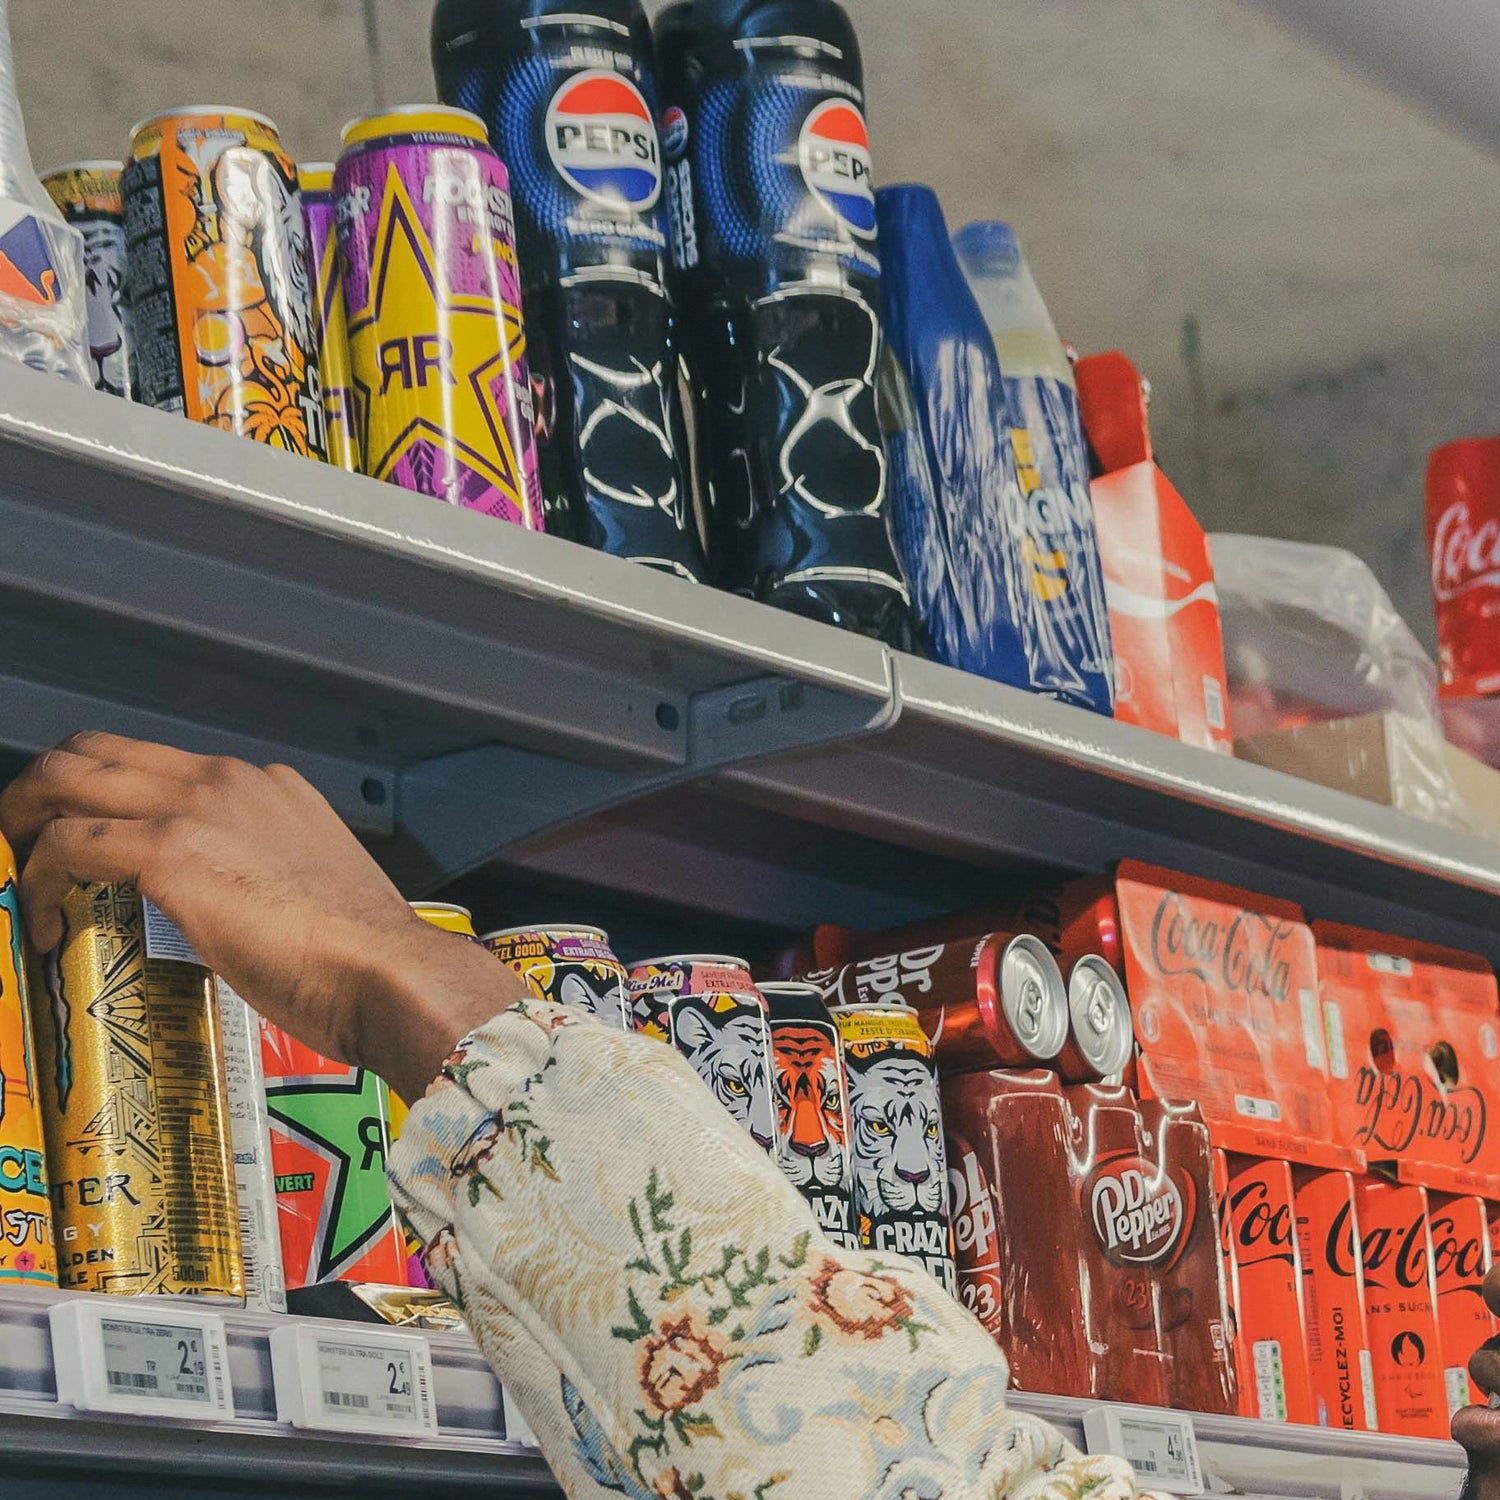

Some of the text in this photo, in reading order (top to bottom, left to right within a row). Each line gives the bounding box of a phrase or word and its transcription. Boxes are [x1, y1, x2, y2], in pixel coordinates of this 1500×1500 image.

[555, 123, 657, 165] PEPSI
[514, 941, 544, 958] GOOD
[652, 970, 681, 990] Me!
[275, 1171, 315, 1195] VERT
[1091, 1172, 1175, 1250] Pepper
[875, 1214, 948, 1253] CRAZY
[171, 1265, 209, 1284] 500ml
[1126, 1278, 1147, 1307] 23
